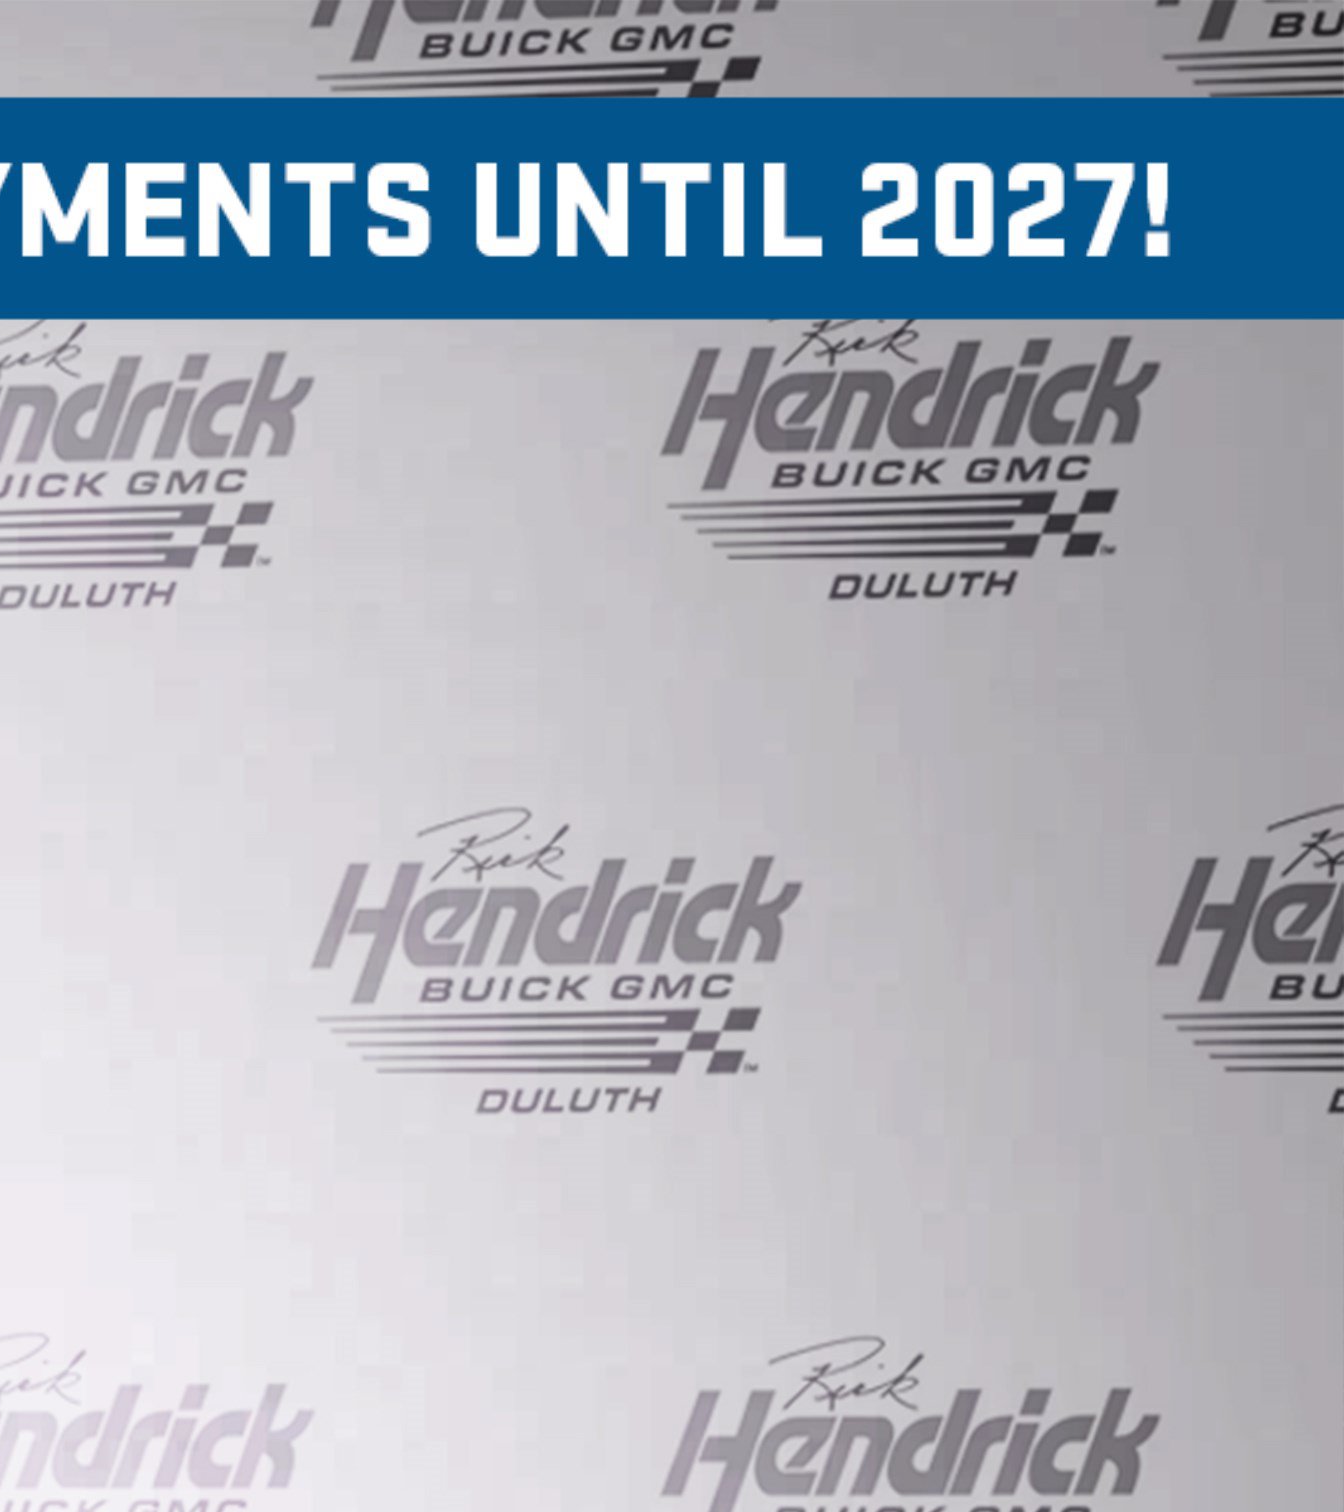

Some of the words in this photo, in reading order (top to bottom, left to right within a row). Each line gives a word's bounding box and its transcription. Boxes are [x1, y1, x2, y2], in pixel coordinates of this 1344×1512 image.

[419, 27, 593, 60] BUICK
[610, 22, 736, 53] GMC
[660, 336, 1161, 491] Hendrick
[126, 468, 248, 497] GMC
[770, 458, 947, 489] BUICK
[965, 455, 1092, 484] GMC
[827, 570, 1018, 600] DULUTH
[310, 855, 803, 1006] Hendrick
[419, 975, 592, 1004] BUICK
[610, 973, 735, 1000] GMC
[475, 1087, 662, 1114] DULUTH
